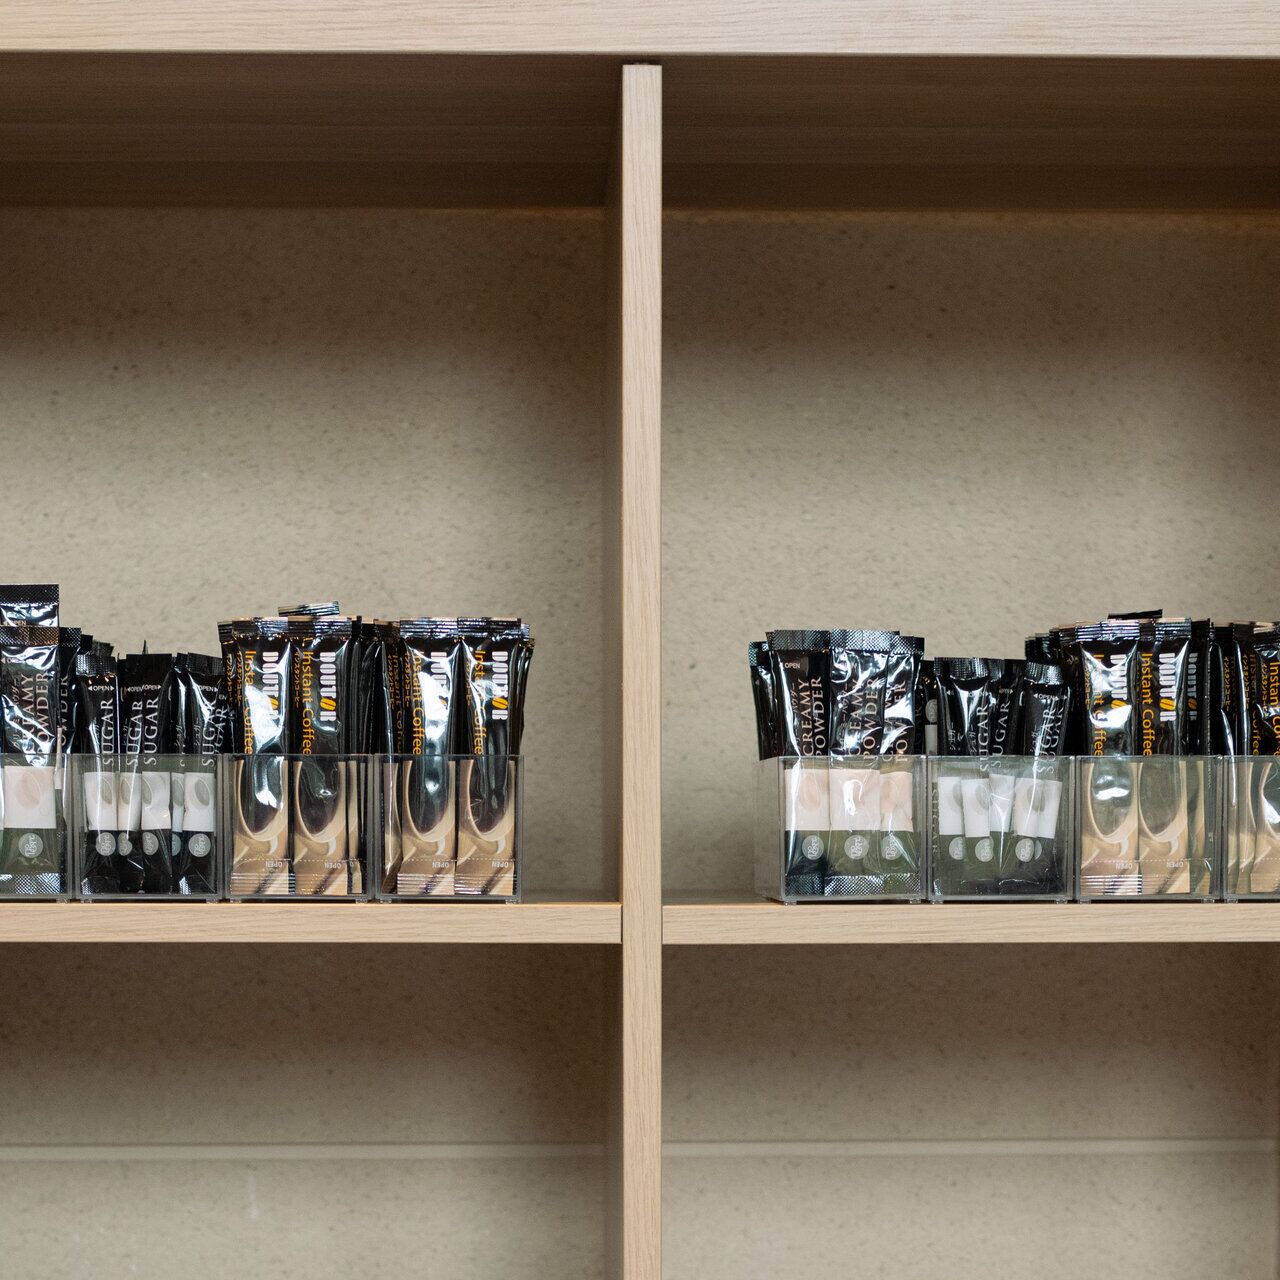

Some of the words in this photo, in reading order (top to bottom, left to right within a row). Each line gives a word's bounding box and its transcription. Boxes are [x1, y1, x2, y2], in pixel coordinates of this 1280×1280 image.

[302, 651, 314, 703] Instant
[320, 652, 337, 722] DOUTOR
[492, 651, 509, 720] DOUTOR
[1141, 653, 1153, 705] Instant
[1159, 653, 1177, 722] DOUTOR
[100, 698, 115, 767] SUGAR
[144, 697, 159, 766] SUGAR
[302, 708, 315, 755] Coffee
[413, 708, 425, 755] Coffee
[798, 679, 815, 756] CREAMY
[976, 703, 990, 771] SUGAR
[991, 700, 1010, 768] SUGAR
[1142, 709, 1155, 756] Coffee
